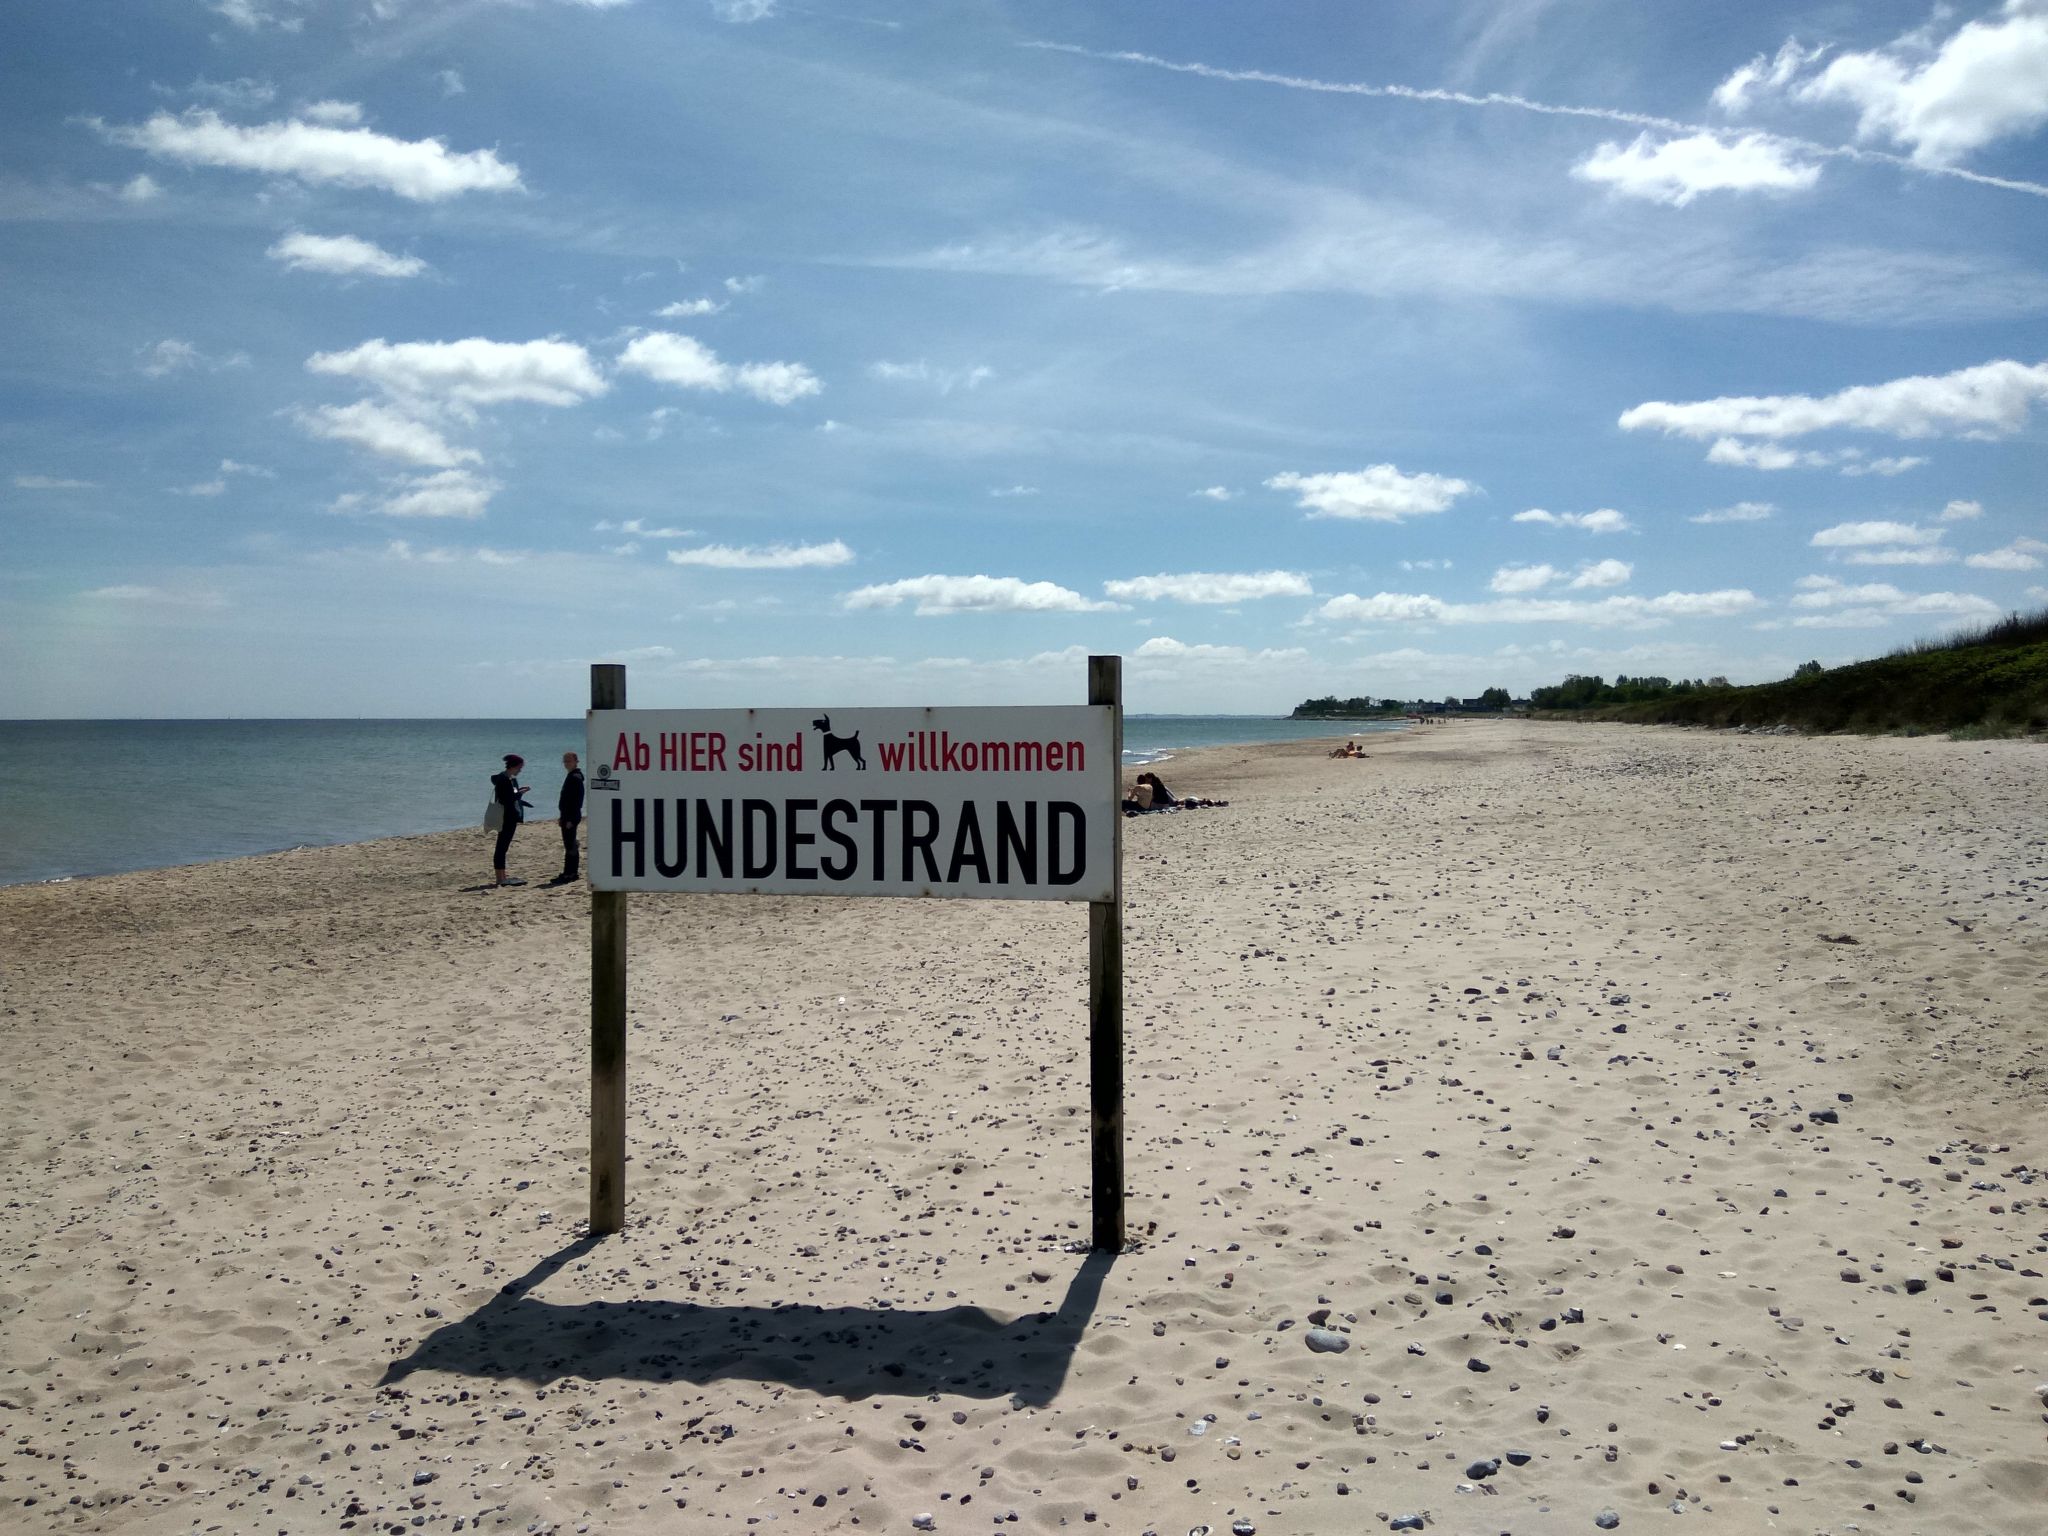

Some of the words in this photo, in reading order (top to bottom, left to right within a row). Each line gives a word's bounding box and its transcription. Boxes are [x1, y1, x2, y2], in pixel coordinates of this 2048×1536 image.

[613, 732, 650, 771] Ab
[660, 732, 727, 771] HIER
[738, 732, 803, 772] sind
[878, 731, 1085, 772] willkommen
[611, 798, 1087, 886] HUNDESTRAND
